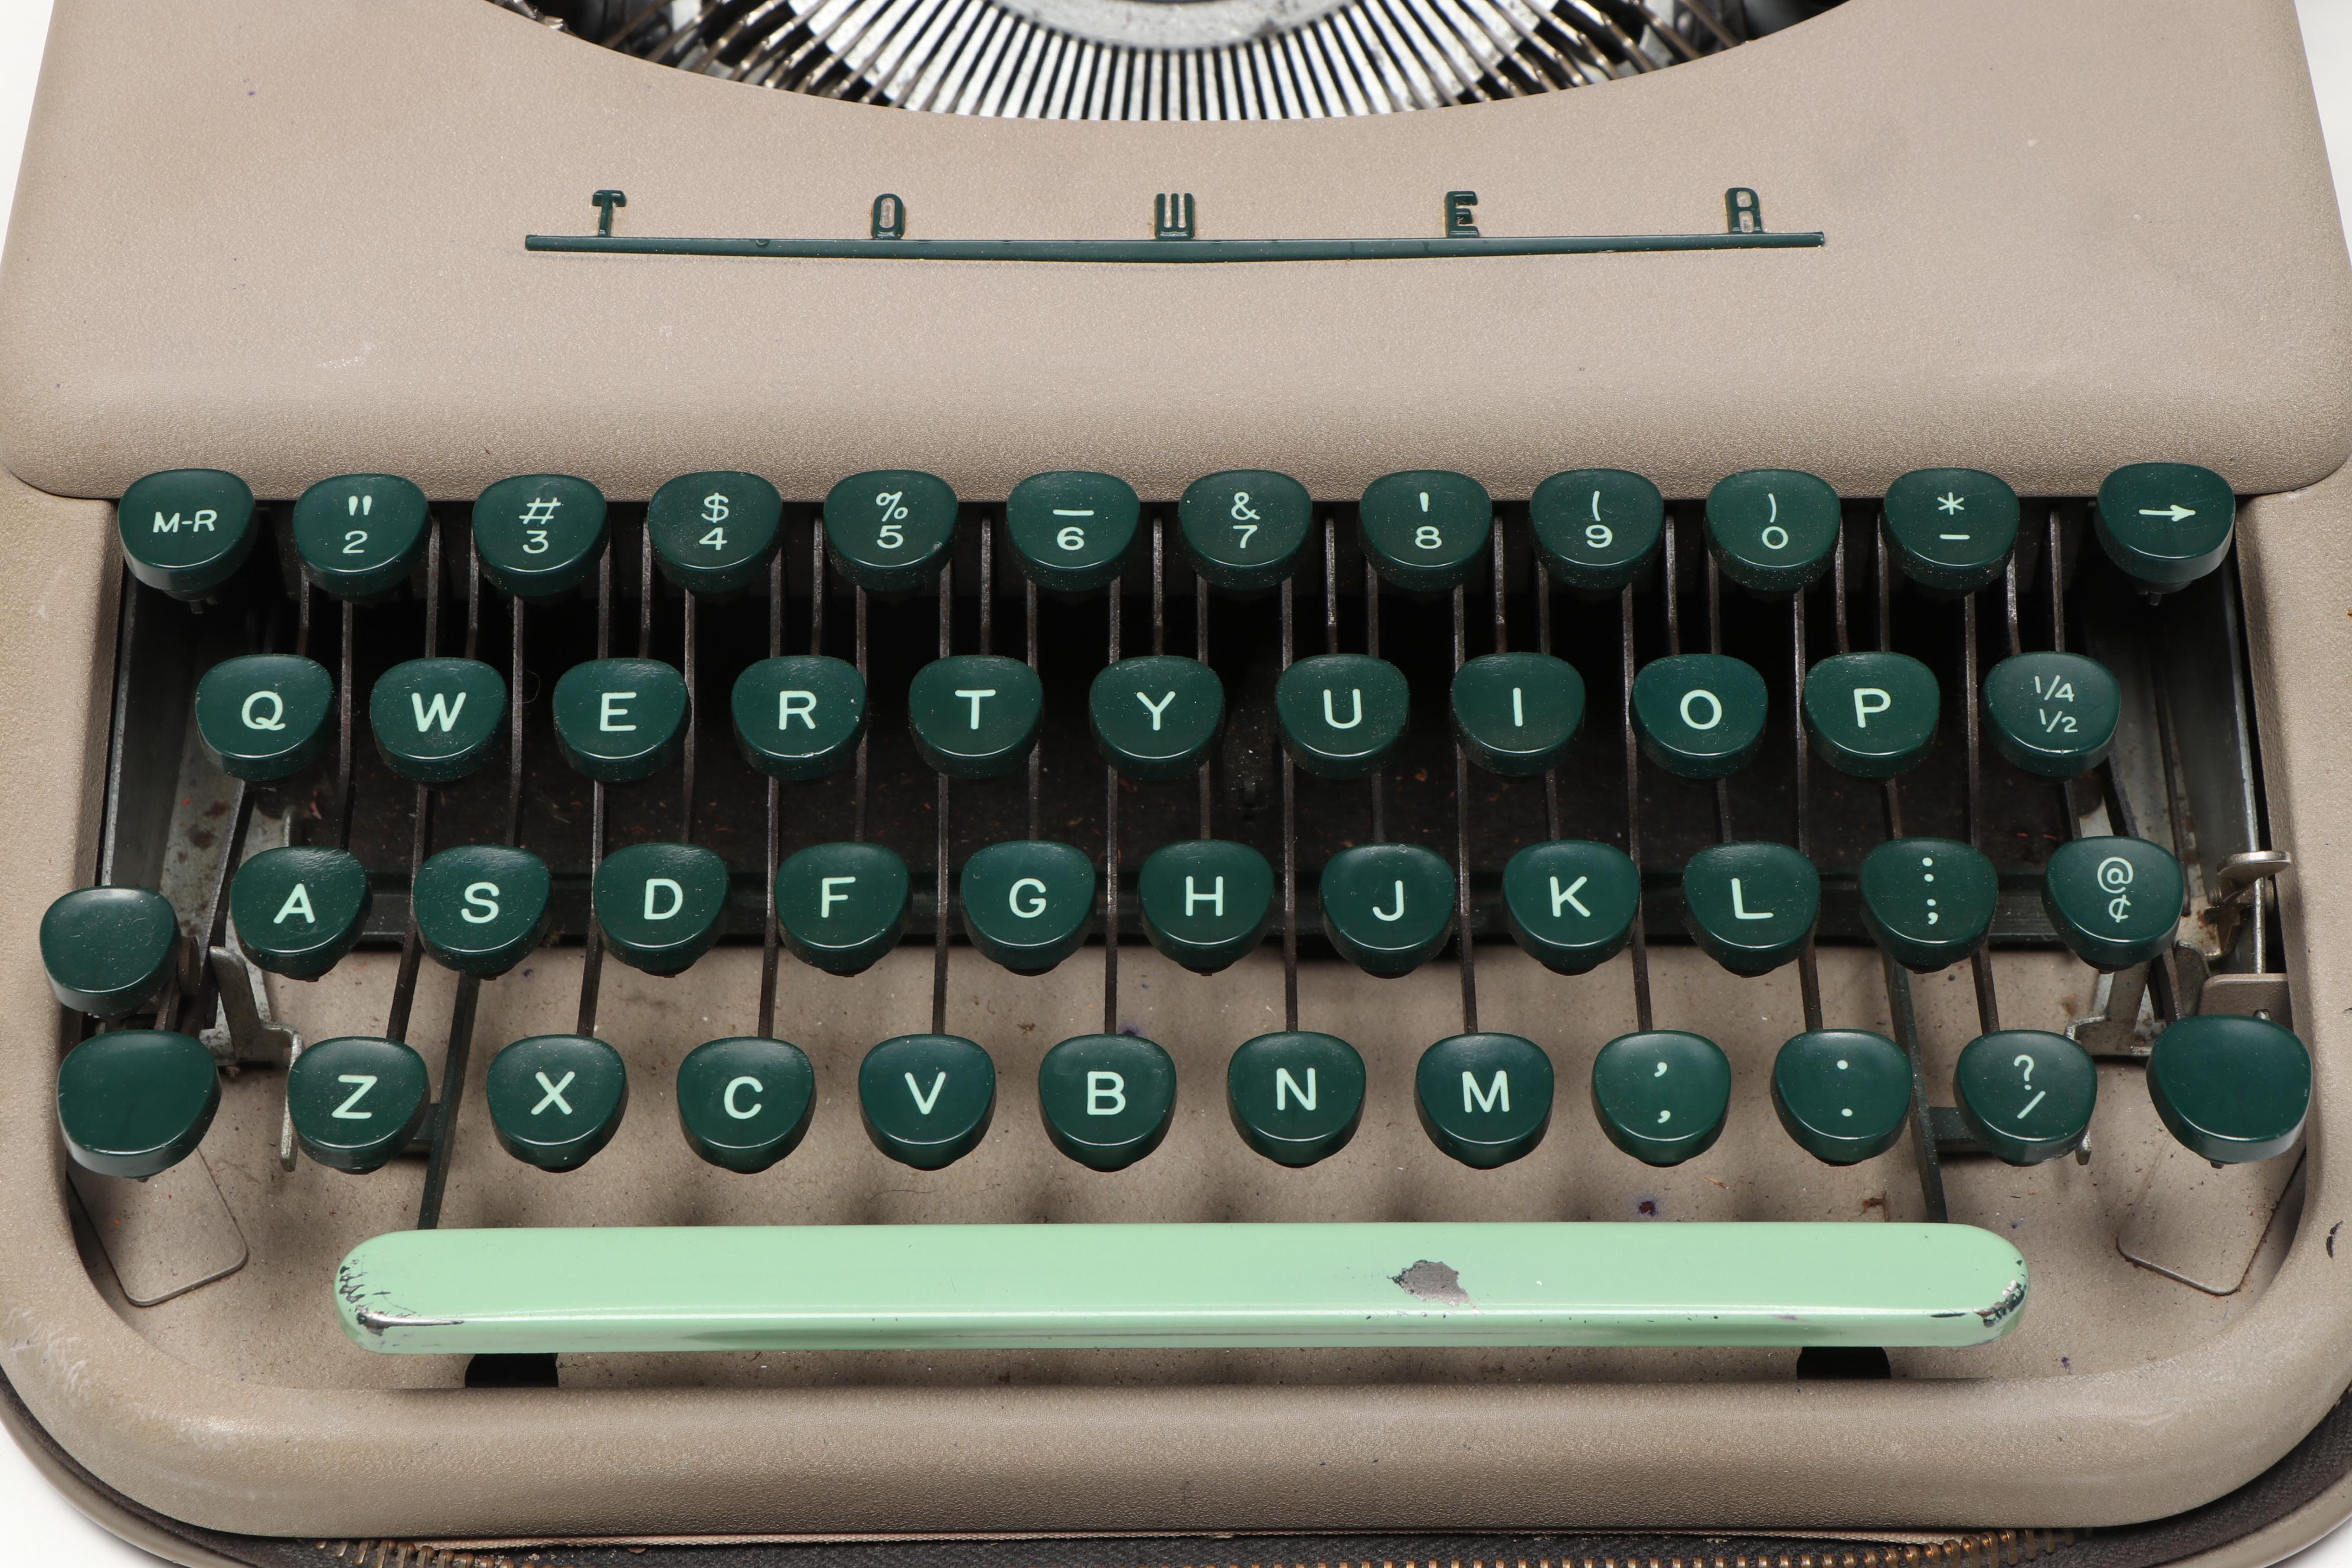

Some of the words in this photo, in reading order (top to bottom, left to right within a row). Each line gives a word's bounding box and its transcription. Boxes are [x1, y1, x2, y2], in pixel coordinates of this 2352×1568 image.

[152, 509, 218, 534] M-R
[518, 496, 562, 525] #
[701, 492, 730, 524] $
[875, 491, 909, 522] %
[1230, 491, 1261, 521] &
[1592, 490, 1602, 522] (
[1768, 492, 1777, 524] )
[342, 530, 368, 554] 2
[522, 530, 550, 554] 3
[698, 527, 729, 551] 4
[876, 524, 904, 550] 5
[1056, 526, 1085, 551] 6
[1232, 524, 1259, 549] 7
[1414, 525, 1443, 550] 8
[1585, 524, 1613, 549] 9
[1761, 525, 1789, 550] 0
[241, 690, 286, 731] Q
[411, 691, 467, 733] W
[599, 691, 638, 732] E
[778, 690, 818, 731] R
[954, 688, 997, 730] T
[1136, 690, 1177, 731] Y
[1322, 688, 1363, 730] U
[1512, 687, 1524, 727] I
[1679, 689, 1723, 730] O
[1853, 687, 1892, 729] P
[2096, 856, 2134, 894] @
[273, 883, 316, 925] A
[460, 881, 500, 924] S
[643, 878, 684, 920] D
[821, 876, 857, 919] F
[1008, 877, 1047, 919] G
[1185, 875, 1224, 917] H
[1372, 880, 1405, 922] J
[1549, 876, 1591, 918] K
[1730, 877, 1774, 920] L
[2108, 894, 2132, 923] ¢
[1276, 1067, 1317, 1111] N
[1461, 1069, 1510, 1113] M
[2013, 1053, 2035, 1091] ?
[331, 1074, 378, 1120] Z
[530, 1070, 576, 1116] X
[723, 1075, 764, 1120] C
[904, 1071, 947, 1115] V
[1086, 1070, 1126, 1116] B
[2017, 1090, 2046, 1119] /
